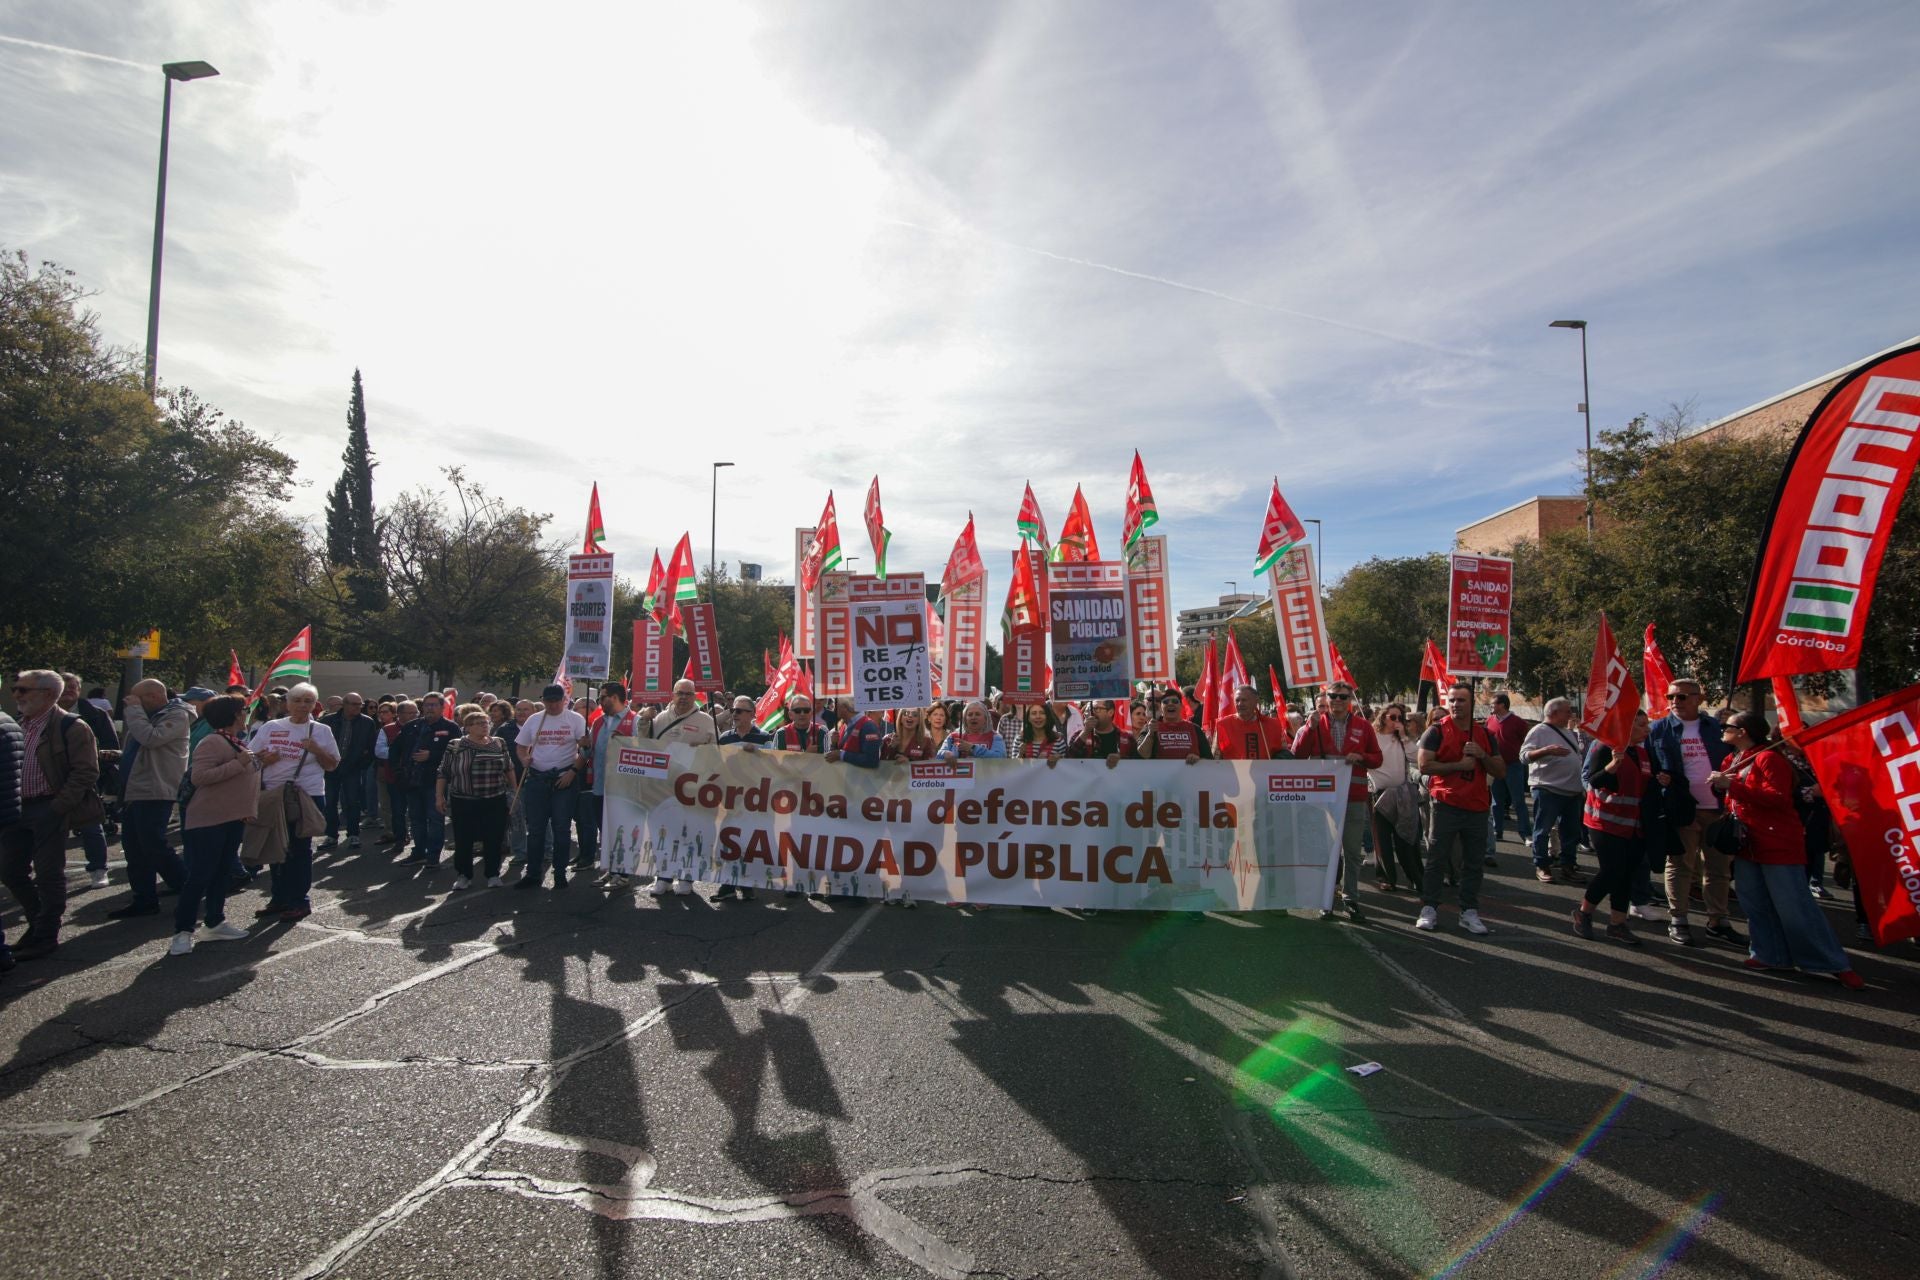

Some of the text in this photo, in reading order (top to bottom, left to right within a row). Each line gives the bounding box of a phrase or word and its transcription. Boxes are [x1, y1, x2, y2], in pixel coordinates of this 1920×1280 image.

[1793, 376, 1920, 585] CCOO
[1049, 565, 1123, 583] CCOO
[849, 579, 924, 596] CCOO
[1467, 579, 1508, 593] SANIDAD
[1460, 591, 1500, 606] PÚBLICA
[570, 603, 606, 616] RECORTES
[1052, 599, 1123, 621] SANIDAD
[855, 614, 922, 647] NO
[1069, 619, 1118, 638] PÚBLICA
[1136, 583, 1161, 672] CCOO
[1456, 620, 1502, 630] DEPENDENCIA
[692, 606, 711, 665] CCOO
[1285, 591, 1320, 679] CCOO
[1776, 633, 1846, 653] Córdoba
[826, 612, 846, 690] CCOO
[862, 648, 889, 663] RE
[954, 610, 975, 691] CCOO
[863, 666, 907, 682] COR
[1055, 663, 1112, 676] para tu salud
[864, 686, 904, 701] TES
[622, 752, 653, 764] CCOO
[618, 765, 645, 776] Córdoba
[914, 766, 954, 776] CCOO
[911, 780, 945, 788] Córdoba
[1272, 779, 1313, 788] CCOO
[674, 773, 1238, 829] Córdoba en defensa de la
[1269, 792, 1306, 801] Córdoba
[719, 826, 1173, 884] SANIDAD PÚBLICA
